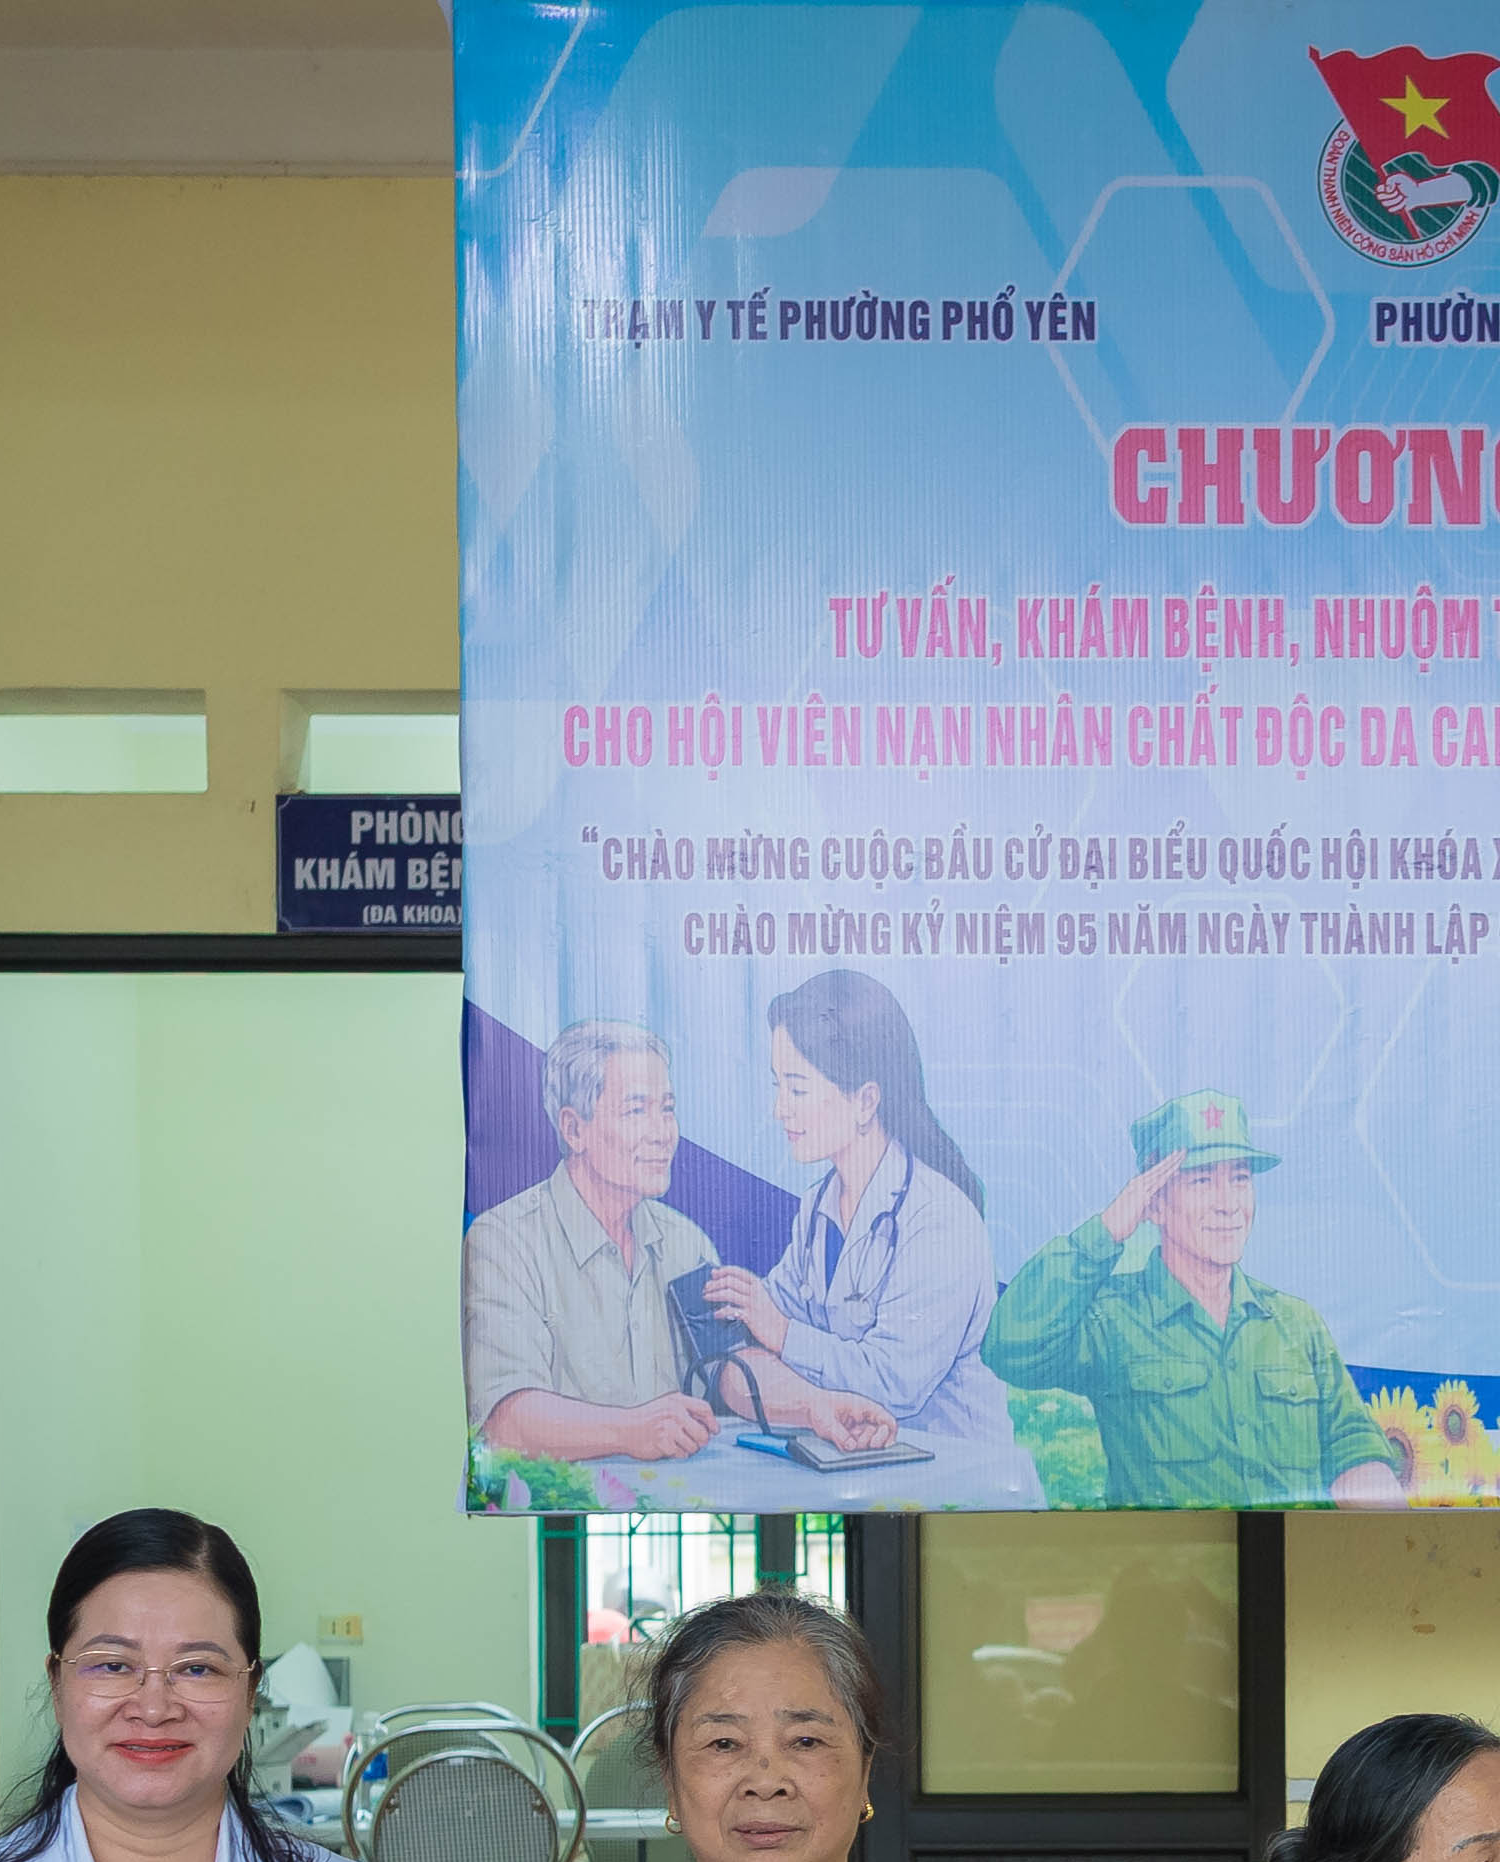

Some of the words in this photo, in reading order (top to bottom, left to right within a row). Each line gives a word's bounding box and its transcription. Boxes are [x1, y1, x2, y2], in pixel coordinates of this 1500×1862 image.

[1324, 164, 1337, 207] THANH
[1456, 211, 1479, 240] MINH
[581, 298, 684, 349] TRẠM
[696, 298, 713, 340] Y
[726, 286, 767, 340] TẾ
[779, 288, 931, 340] PHƯỜNG
[941, 283, 1015, 340] PHỔ
[1025, 290, 1097, 340] YÊN
[829, 591, 891, 658] TƯ
[897, 577, 1002, 666] VẤN,
[1017, 583, 1153, 658] KHÁM
[1164, 585, 1298, 671] BỆNH,
[1314, 585, 1478, 671] NHUỘM
[563, 705, 651, 767] CHO
[667, 689, 745, 780] HỘI
[757, 692, 865, 767] VIÊN
[876, 705, 974, 780] NẠN
[987, 692, 1112, 767] NHÂN
[1127, 684, 1244, 767] CHẤT
[1254, 692, 1345, 780] ĐỘC
[1360, 705, 1417, 767] DA
[294, 851, 396, 890] KHÁM
[706, 825, 809, 881] MỪNG
[820, 826, 917, 891] CUỘC
[926, 826, 994, 881] BẦU
[1004, 825, 1052, 881] CỬ
[1059, 835, 1117, 891] ĐẠI
[1129, 820, 1210, 881] BIỂU
[1218, 820, 1311, 887] QUỐC
[1322, 826, 1377, 891] HỘI
[1389, 826, 1481, 880] KHÓA
[363, 905, 397, 925] (ĐA
[684, 904, 775, 955] CHÀO
[787, 902, 894, 955] MỪNG
[903, 898, 943, 955] KỶ
[955, 902, 1045, 966] NIỆM
[1056, 912, 1096, 955] 95
[1107, 902, 1186, 955] NĂM
[1196, 902, 1289, 955] NGÀY
[1301, 904, 1413, 955] THÀNH
[1425, 902, 1488, 966] LẬP
